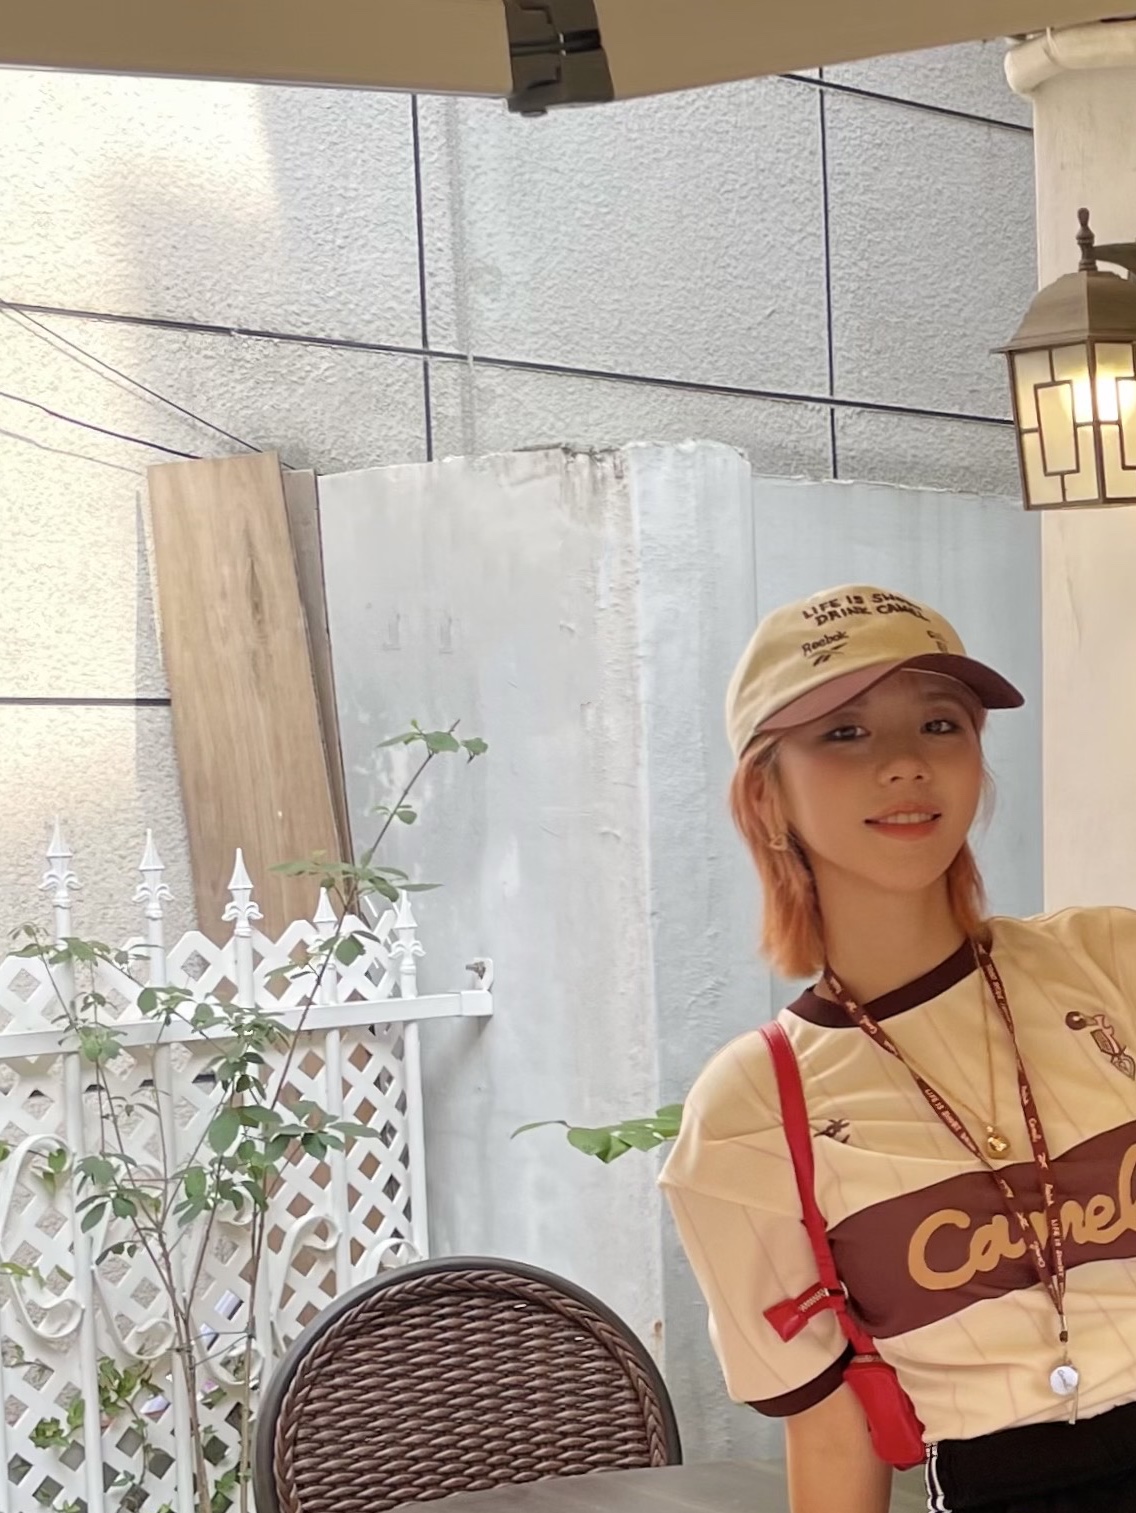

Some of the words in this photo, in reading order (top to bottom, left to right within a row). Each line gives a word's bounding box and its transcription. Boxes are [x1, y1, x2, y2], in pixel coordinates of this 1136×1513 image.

[802, 598, 841, 620] LIFE
[846, 595, 865, 605] IS
[815, 606, 872, 627] DRINK
[801, 631, 850, 657] Reebok
